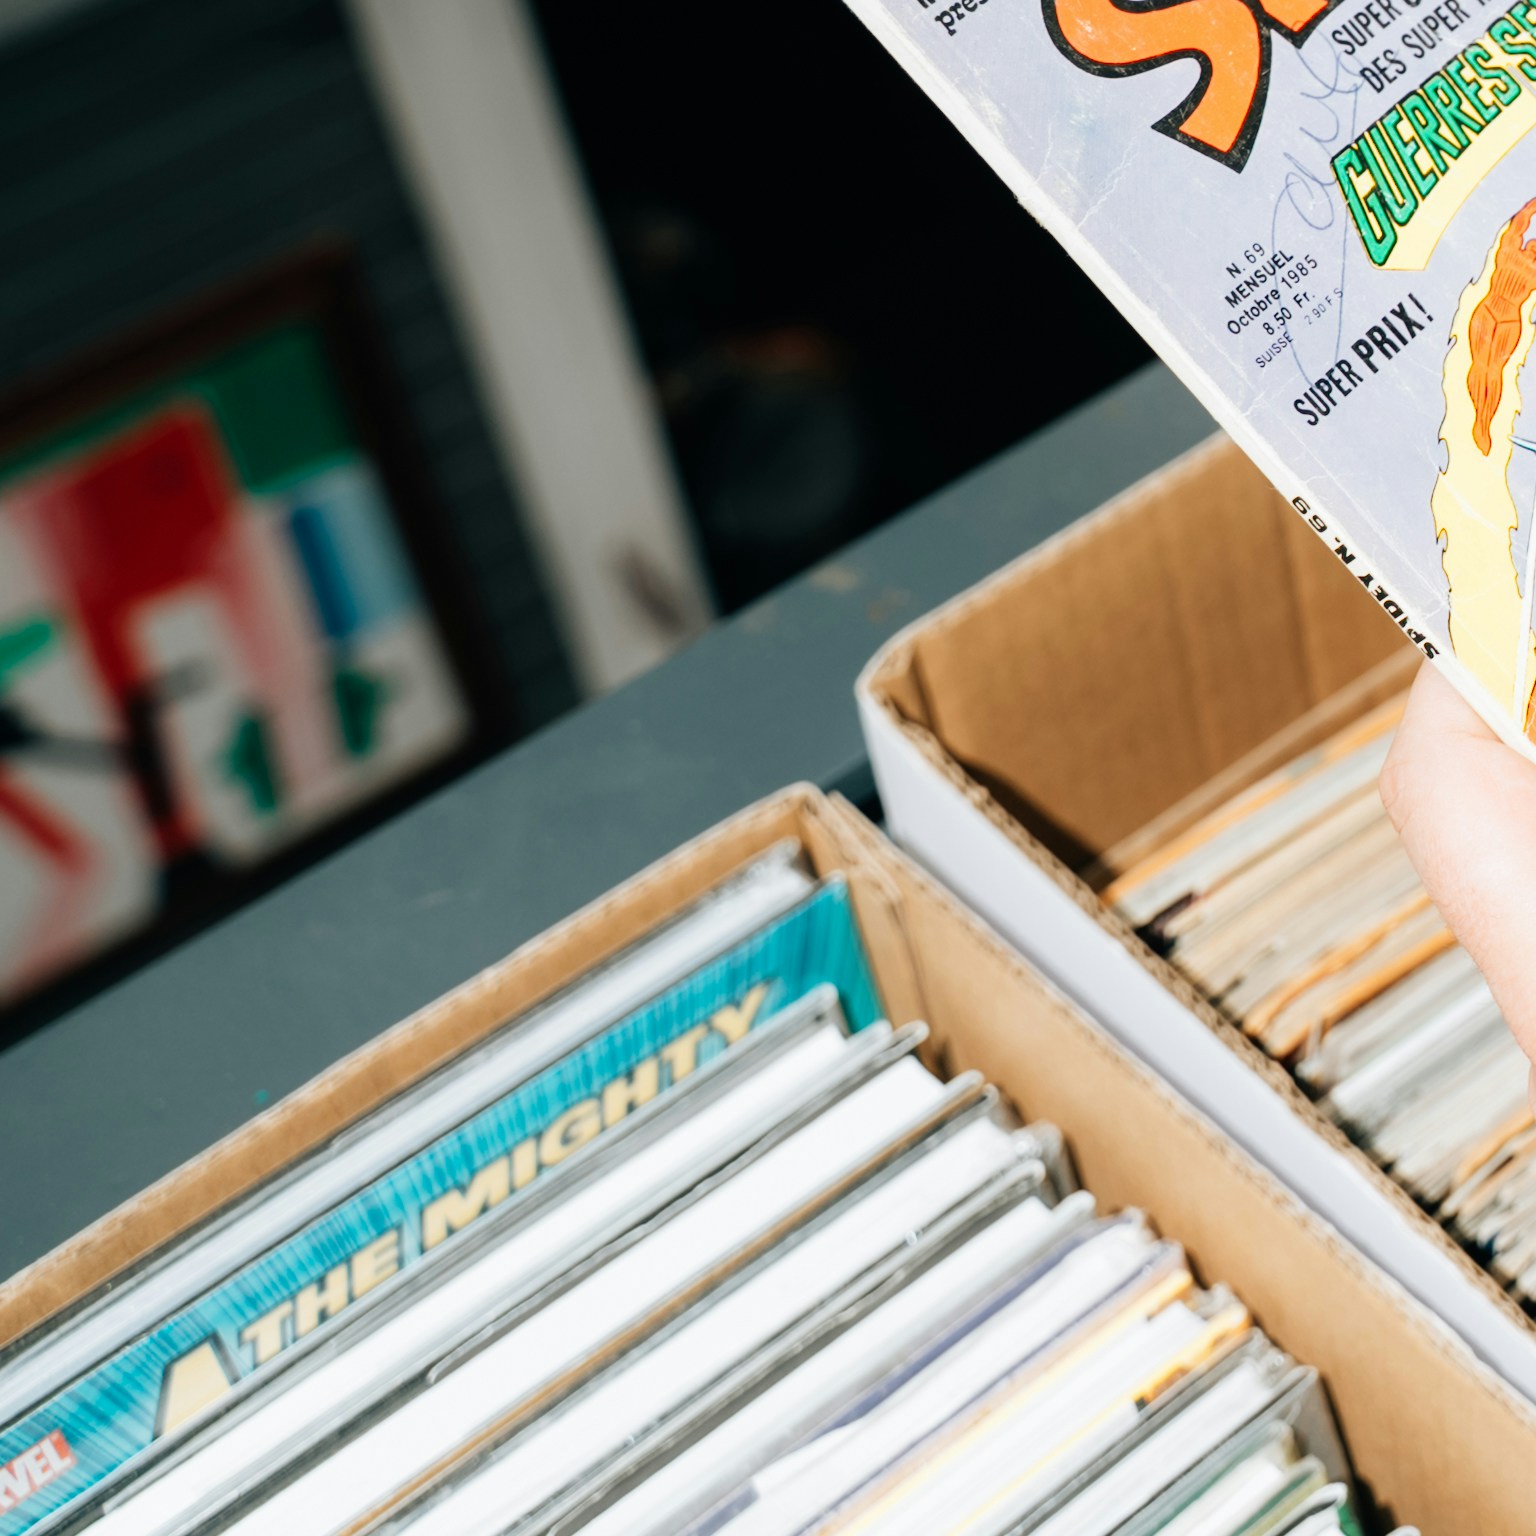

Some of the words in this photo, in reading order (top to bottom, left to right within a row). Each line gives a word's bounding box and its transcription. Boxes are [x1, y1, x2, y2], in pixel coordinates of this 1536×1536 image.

[1359, 49, 1408, 94] DES
[1401, 2, 1471, 59] SUPER
[1329, 41, 1523, 267] GUERRES
[1224, 249, 1294, 308] MENSUEL
[1225, 262, 1246, 279] N.
[1243, 242, 1266, 264] 69
[1227, 288, 1281, 335] Octobre
[1281, 254, 1318, 290] 1985
[1262, 307, 1293, 335] 8.50
[1293, 290, 1316, 308] Fr.
[1255, 331, 1294, 368] SUISSE
[1293, 359, 1364, 426] SUPER
[1292, 496, 1328, 532] 69
[1358, 573, 1440, 659] SPIDEY
[240, 1230, 401, 1365] THE
[421, 981, 772, 1254] MIGHTY
